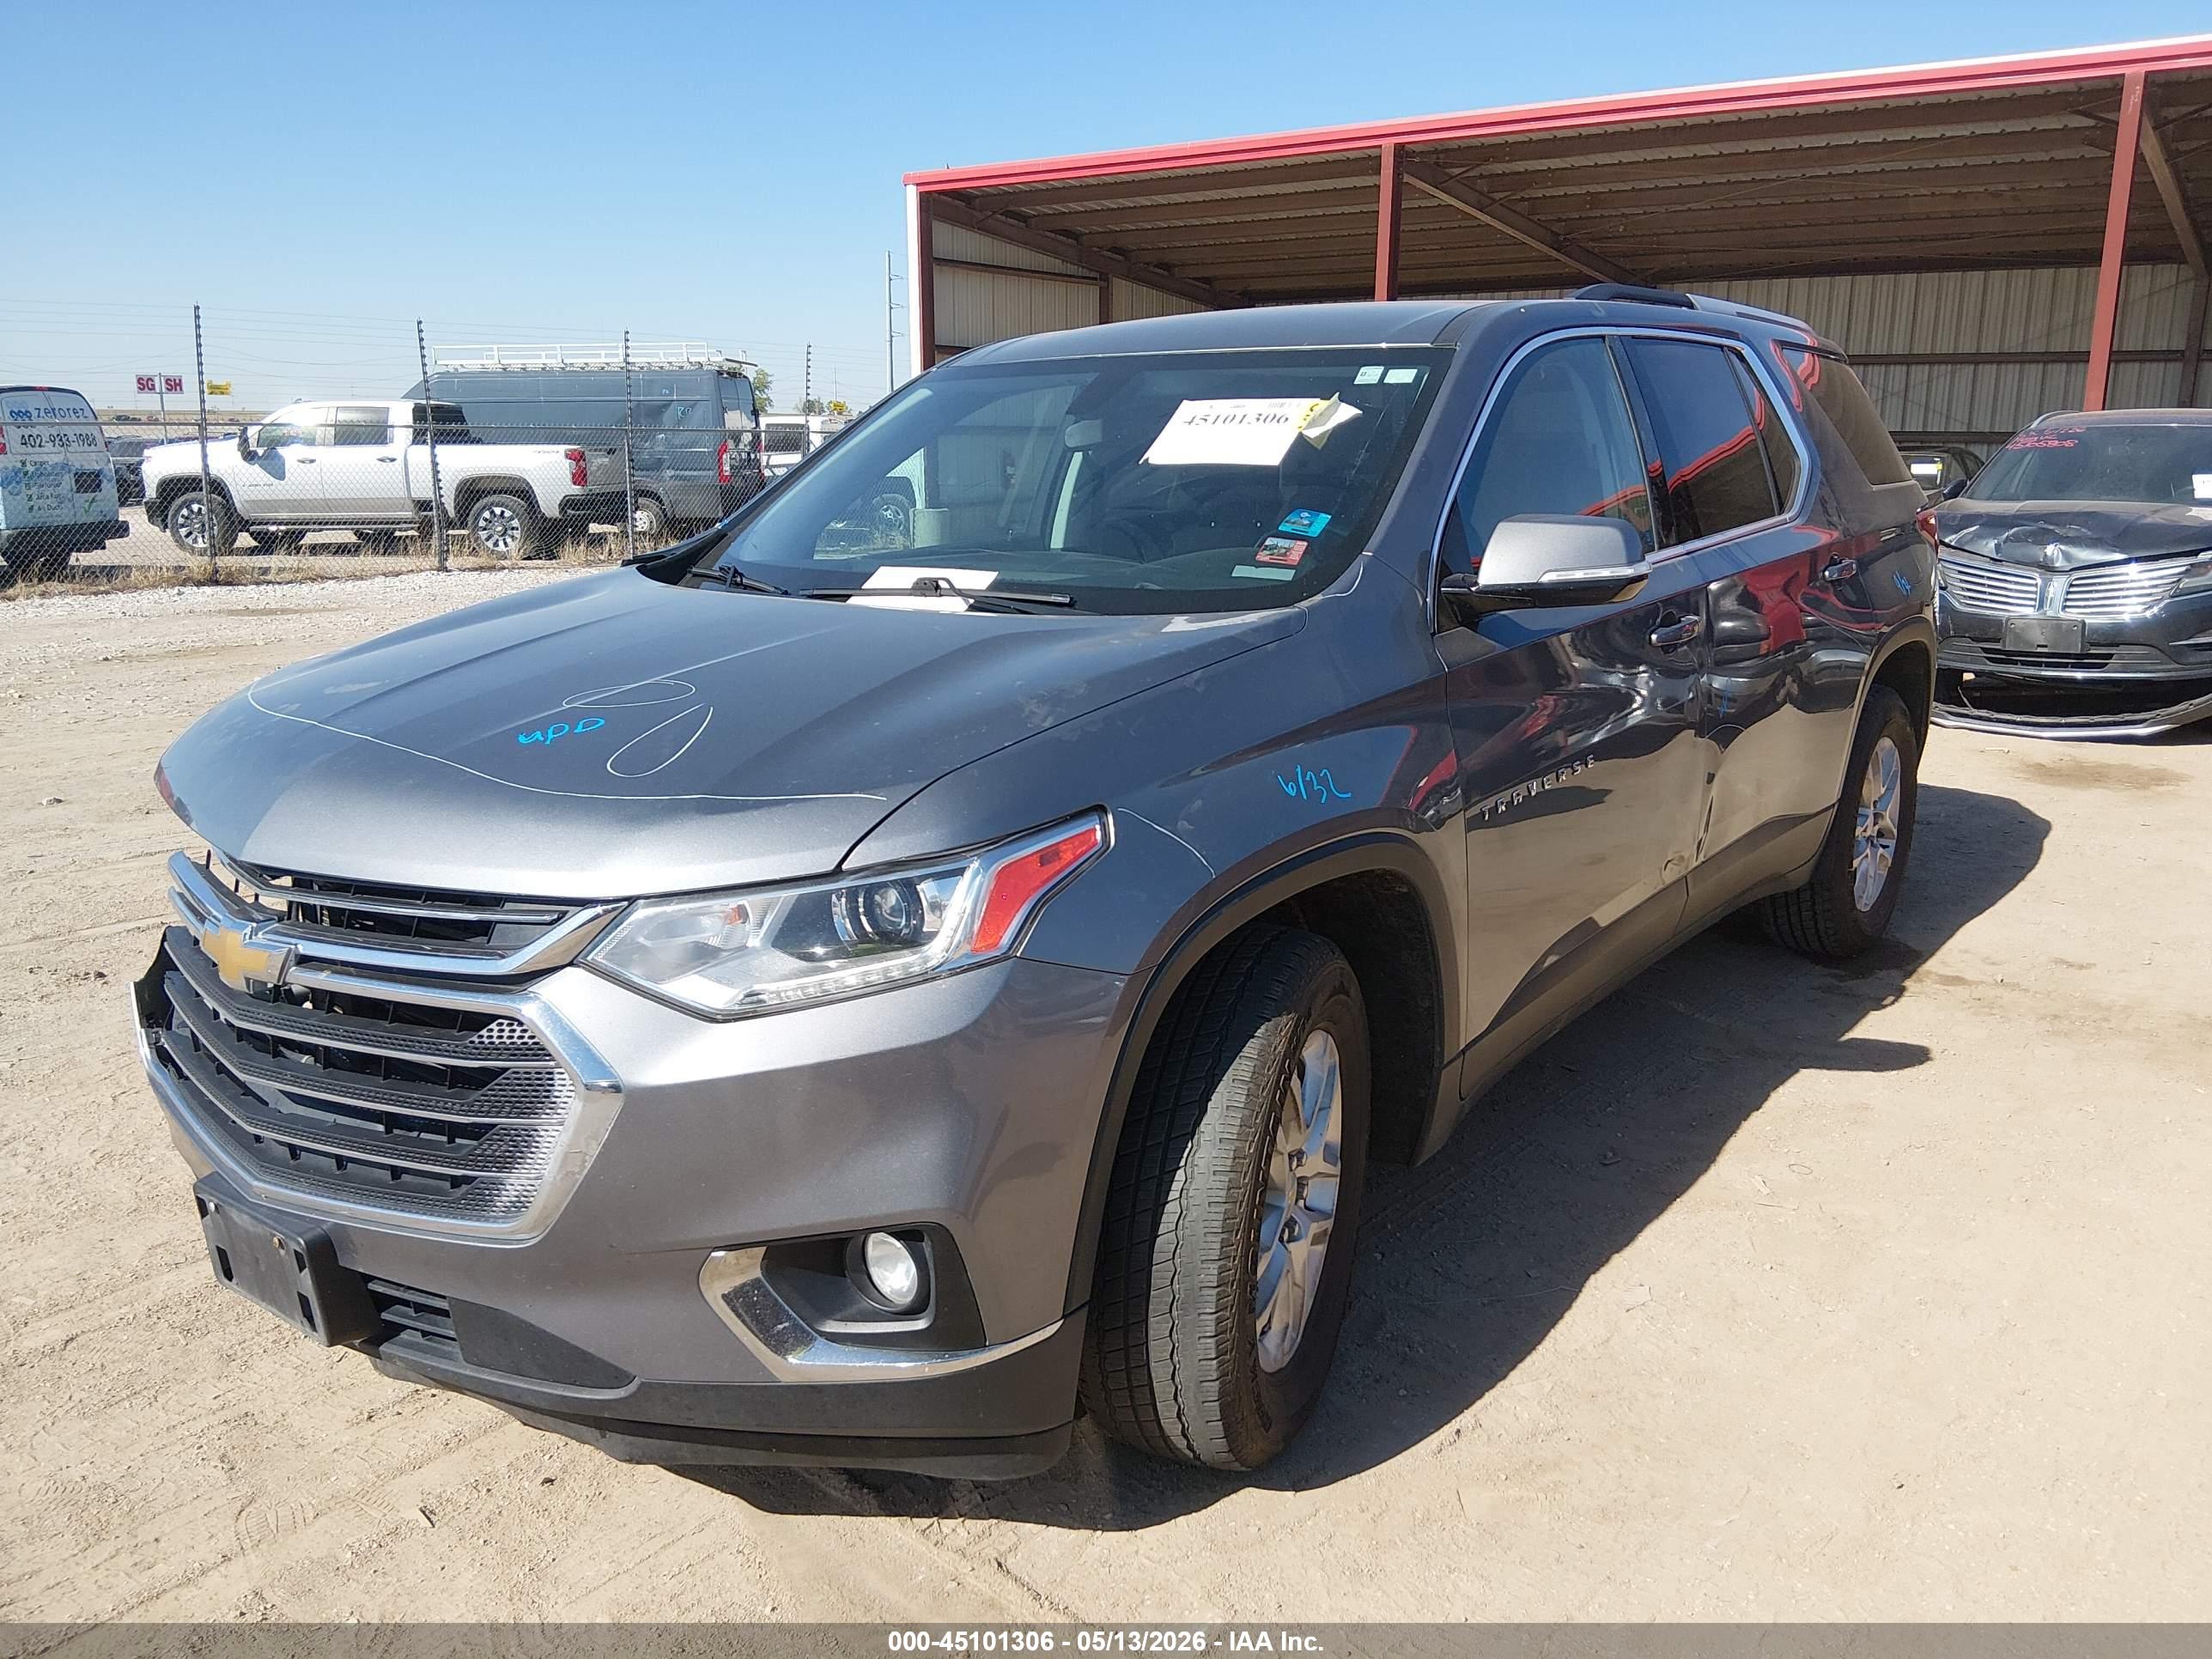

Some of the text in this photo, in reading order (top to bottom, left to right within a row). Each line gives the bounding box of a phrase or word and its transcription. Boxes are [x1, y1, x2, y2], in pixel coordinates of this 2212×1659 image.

[137, 377, 183, 392] SG SH
[34, 407, 88, 419] zerorez
[1183, 413, 1290, 426] 45101306
[1277, 764, 1352, 803] 6/32
[1480, 754, 1595, 821] TRAVERSE
